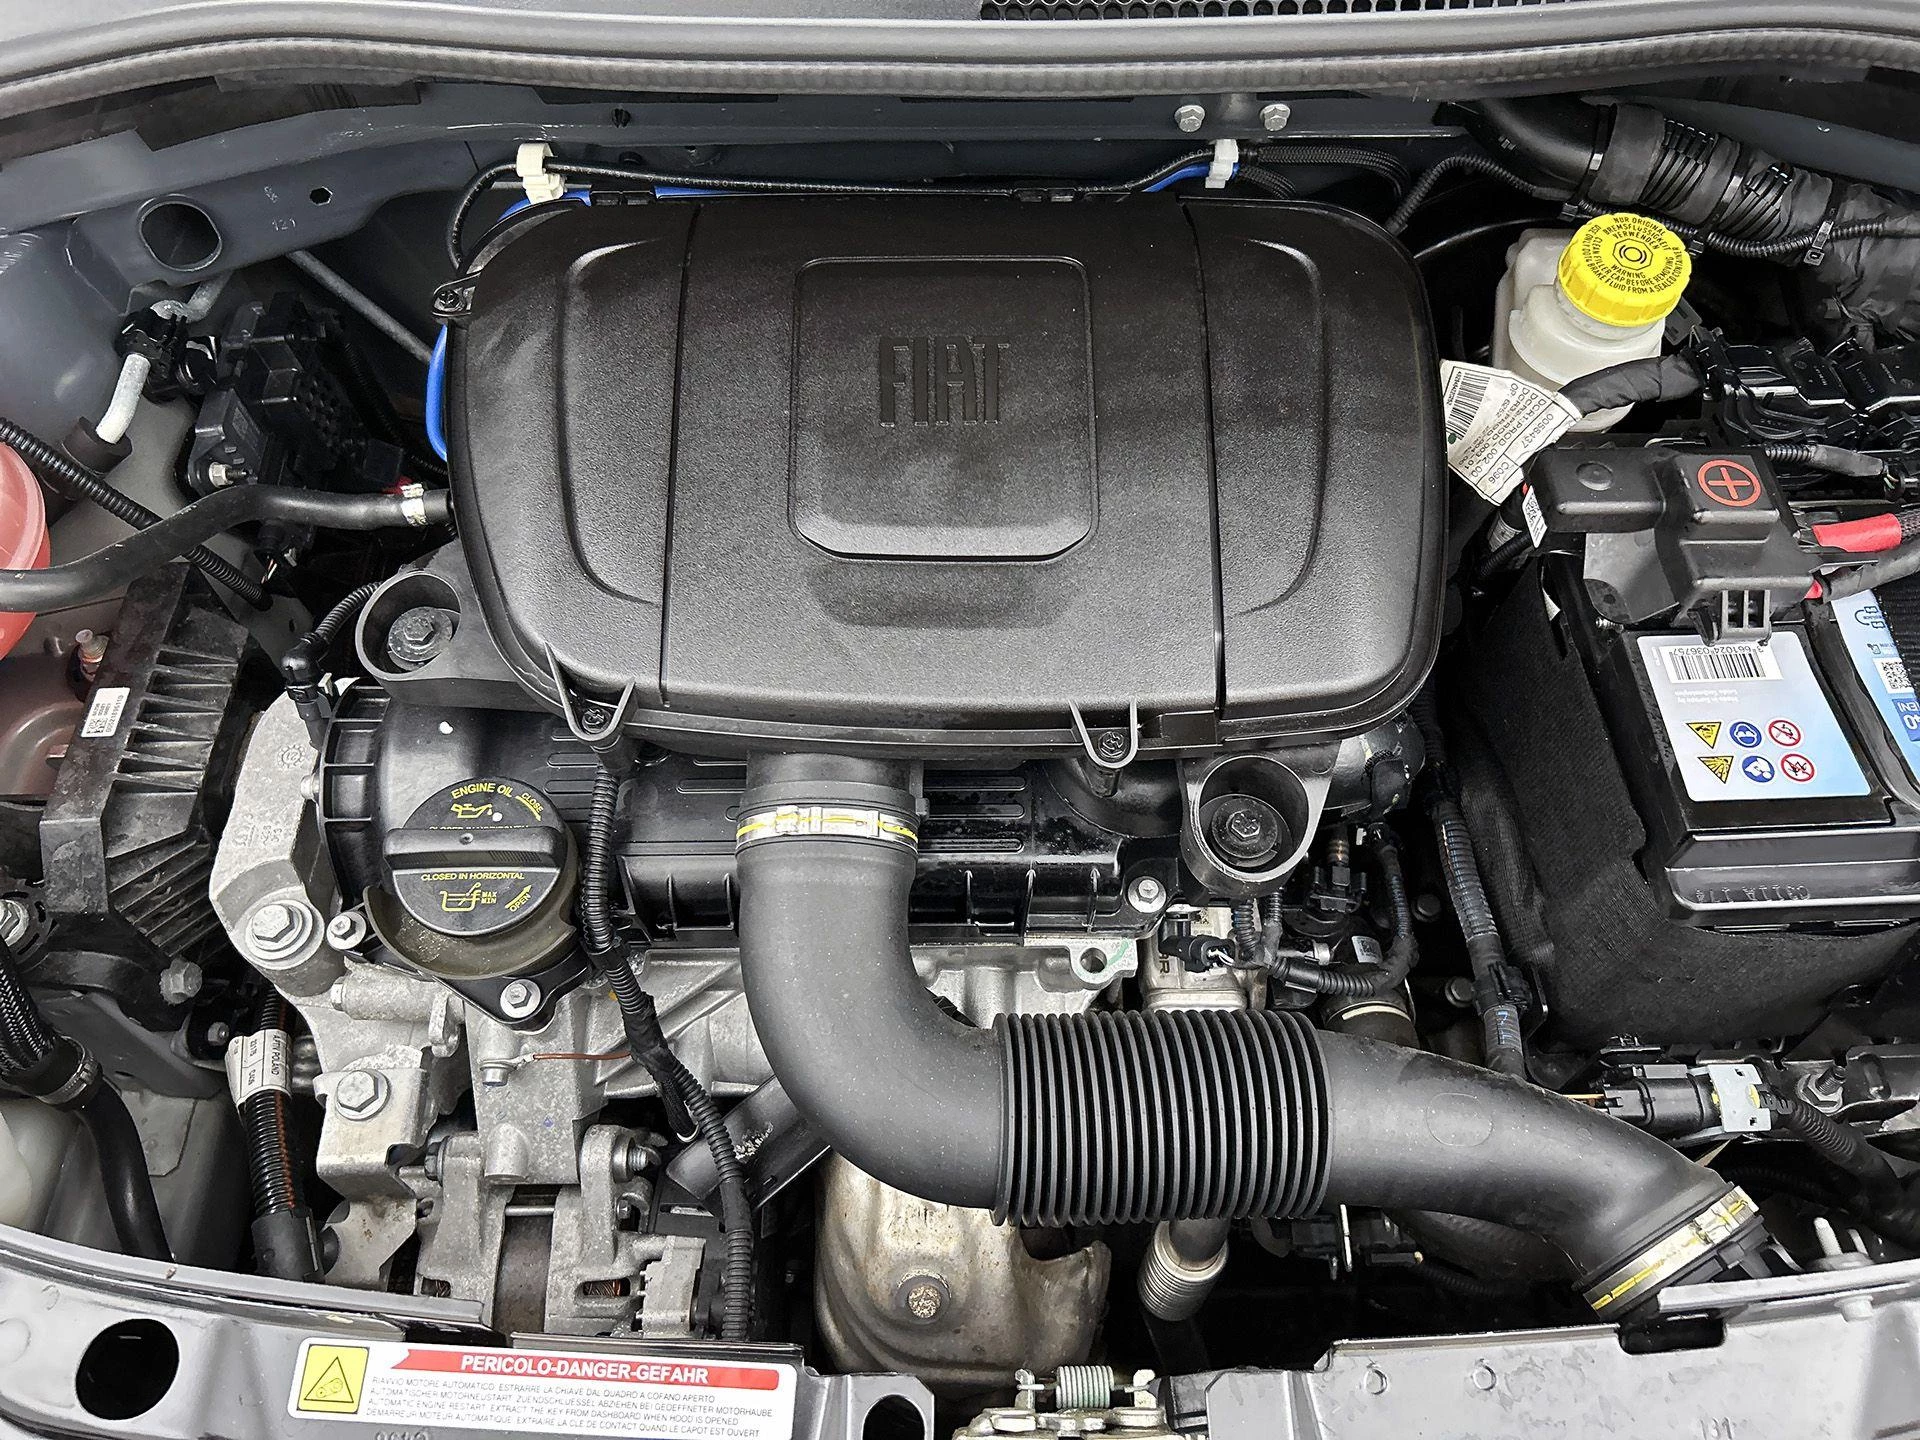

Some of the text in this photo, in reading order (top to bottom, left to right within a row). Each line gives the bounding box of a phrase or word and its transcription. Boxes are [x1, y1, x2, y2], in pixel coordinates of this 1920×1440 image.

[1631, 217, 1666, 237] ORIGINAL
[1613, 230, 1660, 250] VERWENDEN
[1587, 262, 1605, 280] BRAKE
[1605, 278, 1626, 291] FLUID
[1627, 286, 1648, 294] FROM
[1649, 286, 1655, 294] A
[1655, 277, 1677, 293] SEALED
[1594, 255, 1613, 275] FILLER
[1611, 272, 1625, 283] CAP
[1626, 278, 1655, 286] BEFORE
[1654, 256, 1673, 283] REMOVING
[1611, 264, 1646, 279] WARNING
[879, 336, 1010, 427] FIAT
[1672, 646, 1709, 655] 036757
[1713, 645, 1751, 653] 661024
[451, 782, 515, 799] ENGINE OIL
[521, 792, 544, 813] CLOSE
[421, 871, 525, 881] CLOSED IN HORIZONTAL
[509, 894, 532, 912] OPEN
[460, 1354, 709, 1384] PERICOLO-DANGER-GEFAHR
[372, 1376, 404, 1386] RIAVVIO
[406, 1378, 439, 1387] MOTORE
[498, 1383, 541, 1393] ESTRARRE
[554, 1386, 584, 1396] CHIAVE
[586, 1388, 601, 1396] DAL
[603, 1389, 638, 1398] QUADRO
[640, 1391, 646, 1399] A
[647, 1391, 681, 1401] COFANO
[682, 1394, 715, 1403] APERTO
[368, 1398, 415, 1408] AUTOMATIC
[416, 1400, 446, 1409] ENGINE
[490, 1404, 527, 1413] EXTRACT
[530, 1406, 545, 1414] THE
[547, 1407, 562, 1415] KEY
[565, 1408, 589, 1417] FROM
[591, 1410, 641, 1420] DASHBOARD
[643, 1413, 667, 1421] WHEN
[669, 1414, 693, 1423] HOOD
[705, 1416, 739, 1426] OPENED
[370, 1388, 438, 1398] AUTOMATISCHER
[516, 1394, 595, 1407] ZUENDSCHLUESSEL
[597, 1400, 638, 1409] ABZIEHEN
[655, 1403, 714, 1414] GEOEFFNETER
[716, 1406, 772, 1417] MOTORHAUBE
[366, 1408, 417, 1416] DEMARREUR
[419, 1411, 453, 1420] MOTEUR
[517, 1416, 555, 1426] EXTRAIRE
[557, 1419, 567, 1427] LA
[569, 1418, 584, 1428] CLE
[586, 1420, 597, 1428] DE
[599, 1421, 637, 1431] CONTACT
[639, 1424, 667, 1433] QUAND
[669, 1424, 679, 1433] LE
[681, 1426, 707, 1435] CAPOT
[710, 1427, 725, 1436] EST
[727, 1428, 760, 1437] OUVERT
